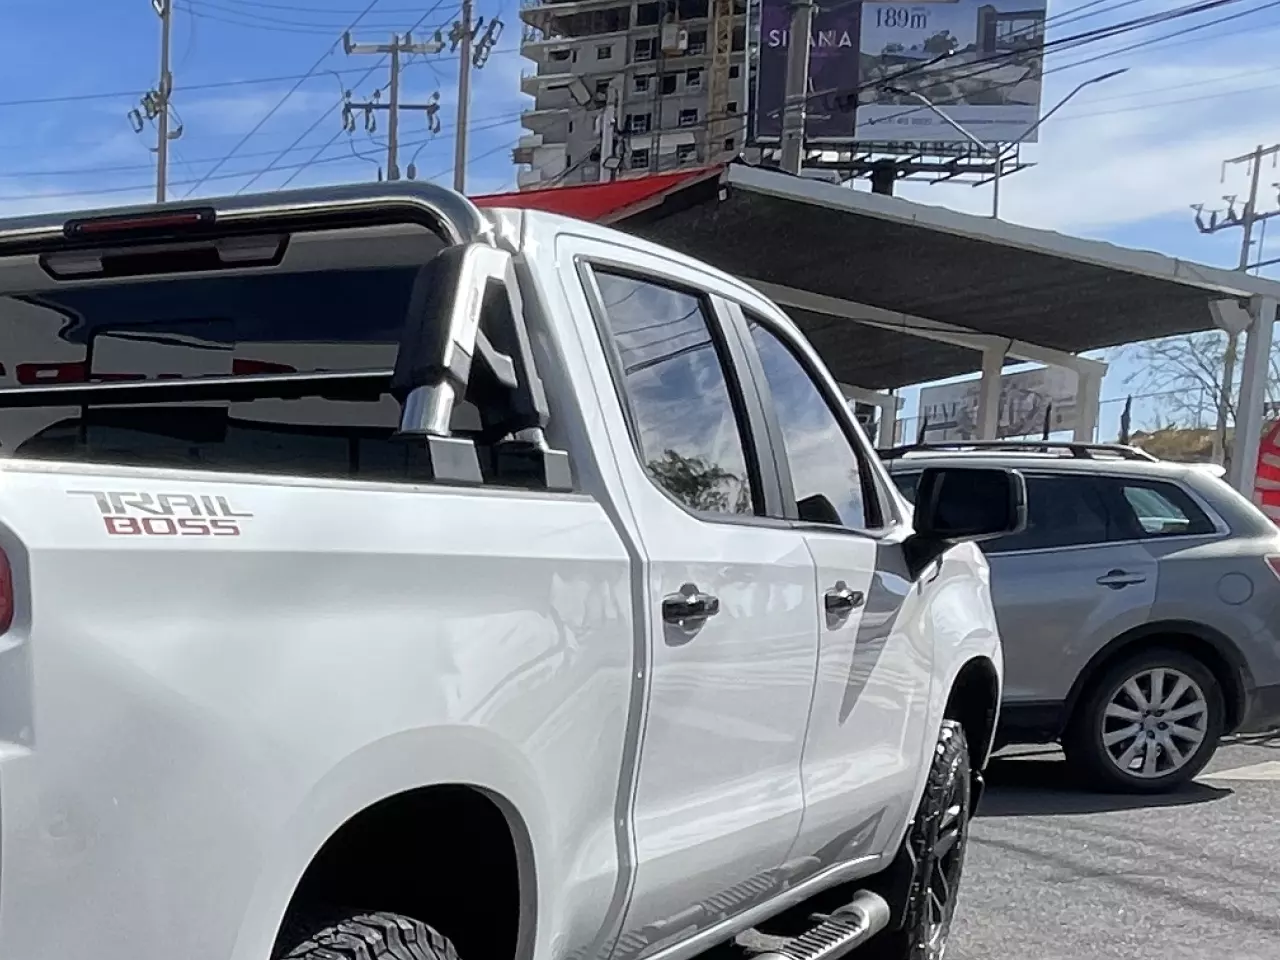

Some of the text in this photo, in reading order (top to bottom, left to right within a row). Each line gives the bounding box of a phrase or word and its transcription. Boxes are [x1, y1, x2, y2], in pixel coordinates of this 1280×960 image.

[768, 29, 852, 48] SINA
[66, 490, 254, 517] TRAIL
[103, 516, 241, 536] BOSS
